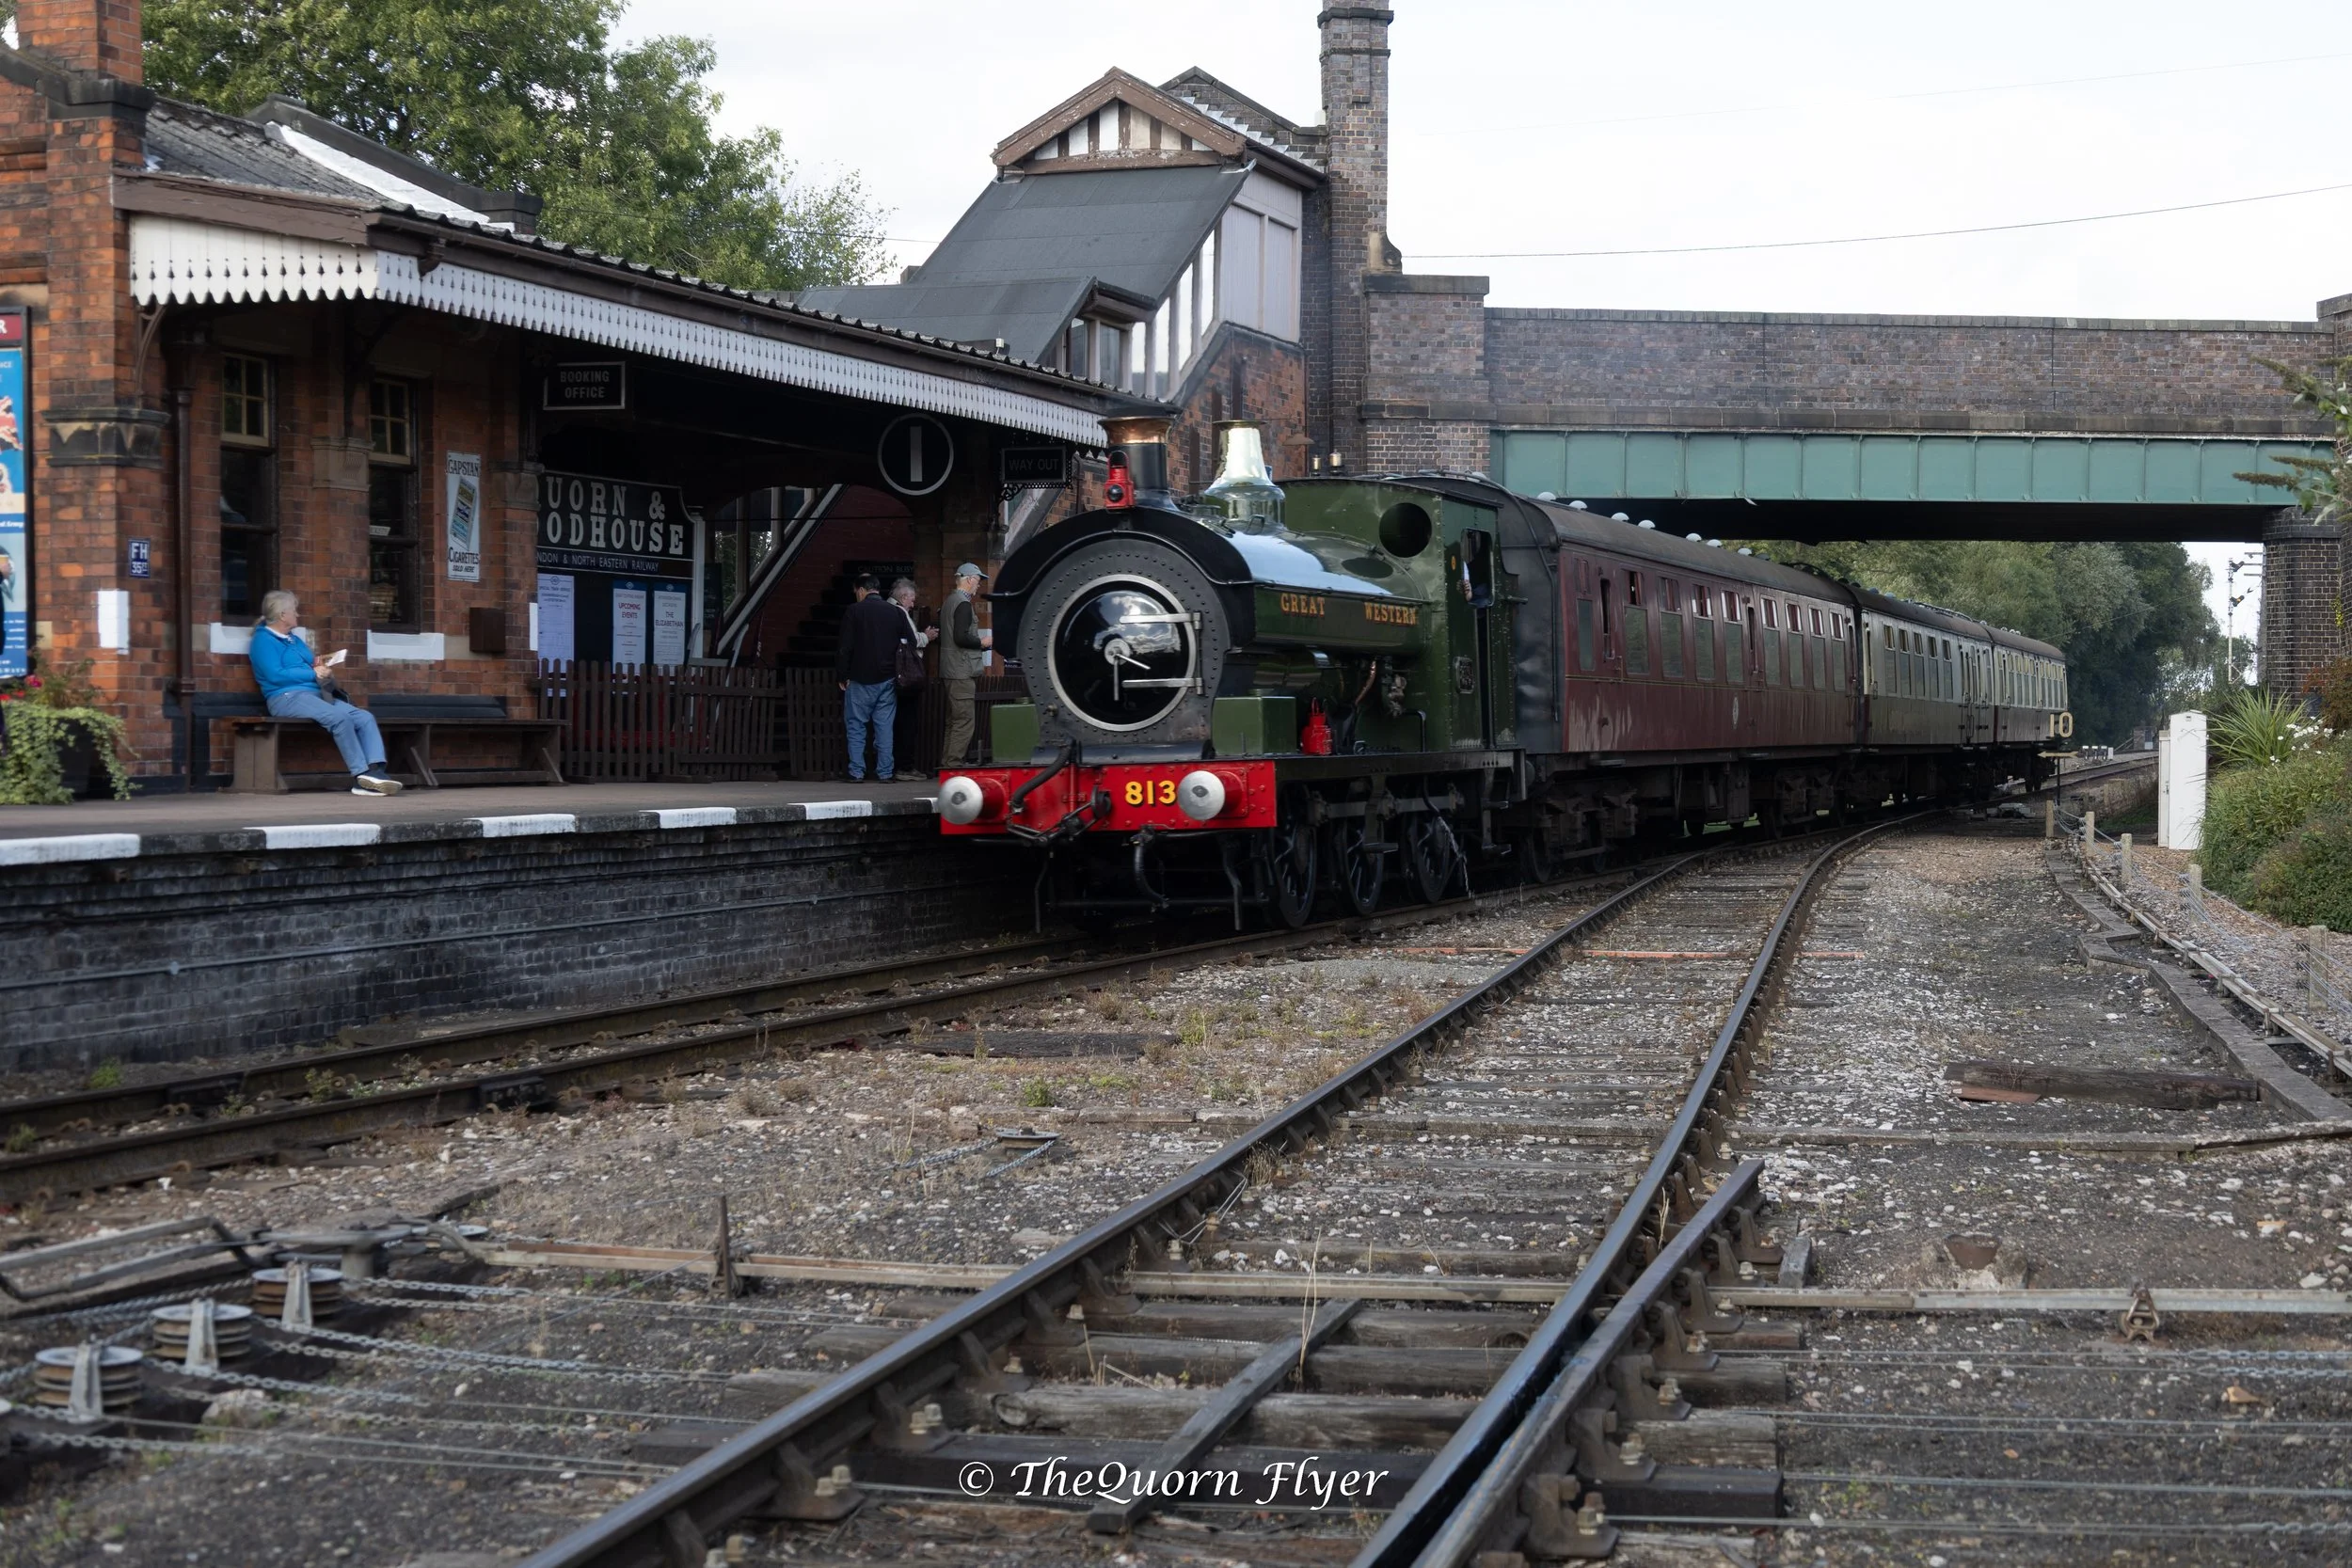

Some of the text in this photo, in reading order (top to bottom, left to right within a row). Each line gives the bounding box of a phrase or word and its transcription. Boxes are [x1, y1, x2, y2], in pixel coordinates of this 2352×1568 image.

[560, 371, 610, 383] BOOKING
[564, 387, 605, 399] OFFICE
[448, 459, 479, 477] CAPSTAN
[1009, 459, 1058, 470] WAY OUT
[546, 476, 665, 520] UORN &
[536, 511, 684, 555] ODHOUSE
[132, 543, 147, 559] FH
[534, 552, 558, 562] NDON
[572, 555, 595, 566] NORTH
[599, 558, 628, 569] EASTERN
[631, 560, 658, 572] RAILWAY
[1280, 593, 1417, 626] GREAT WESTERN
[2050, 712, 2073, 737] 10
[1125, 780, 1177, 805] 813
